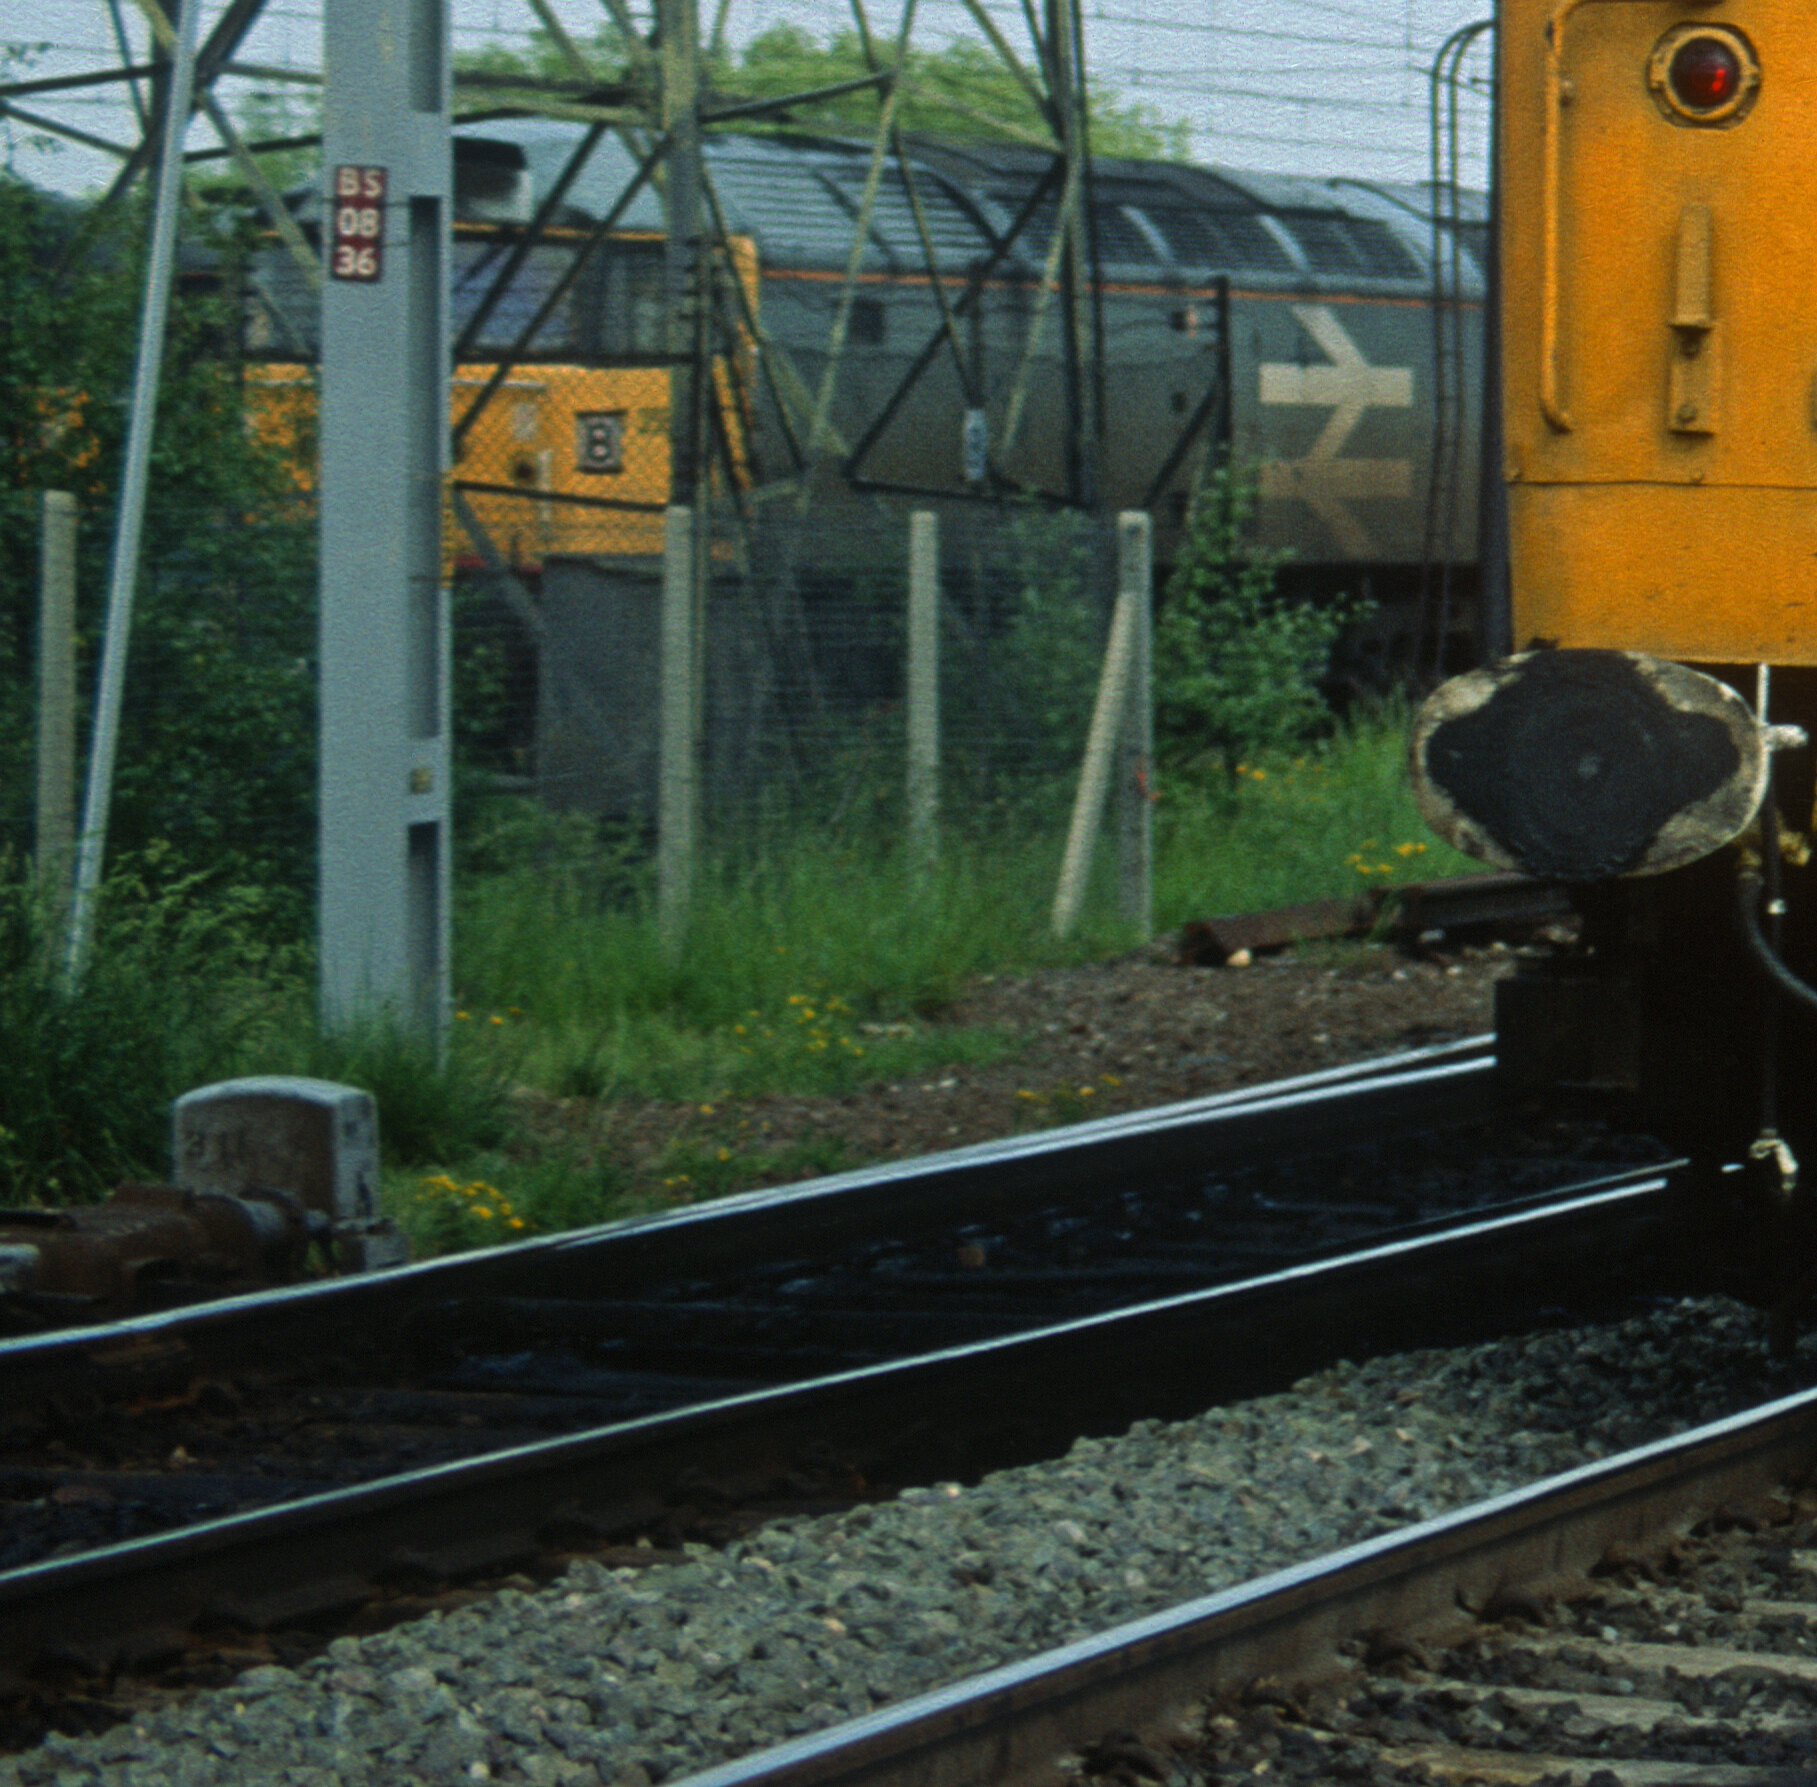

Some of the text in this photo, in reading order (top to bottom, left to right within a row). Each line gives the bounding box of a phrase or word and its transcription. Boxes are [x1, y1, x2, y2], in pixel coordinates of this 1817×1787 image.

[337, 167, 383, 199] BS
[336, 207, 381, 238] 08
[335, 245, 378, 276] 36
